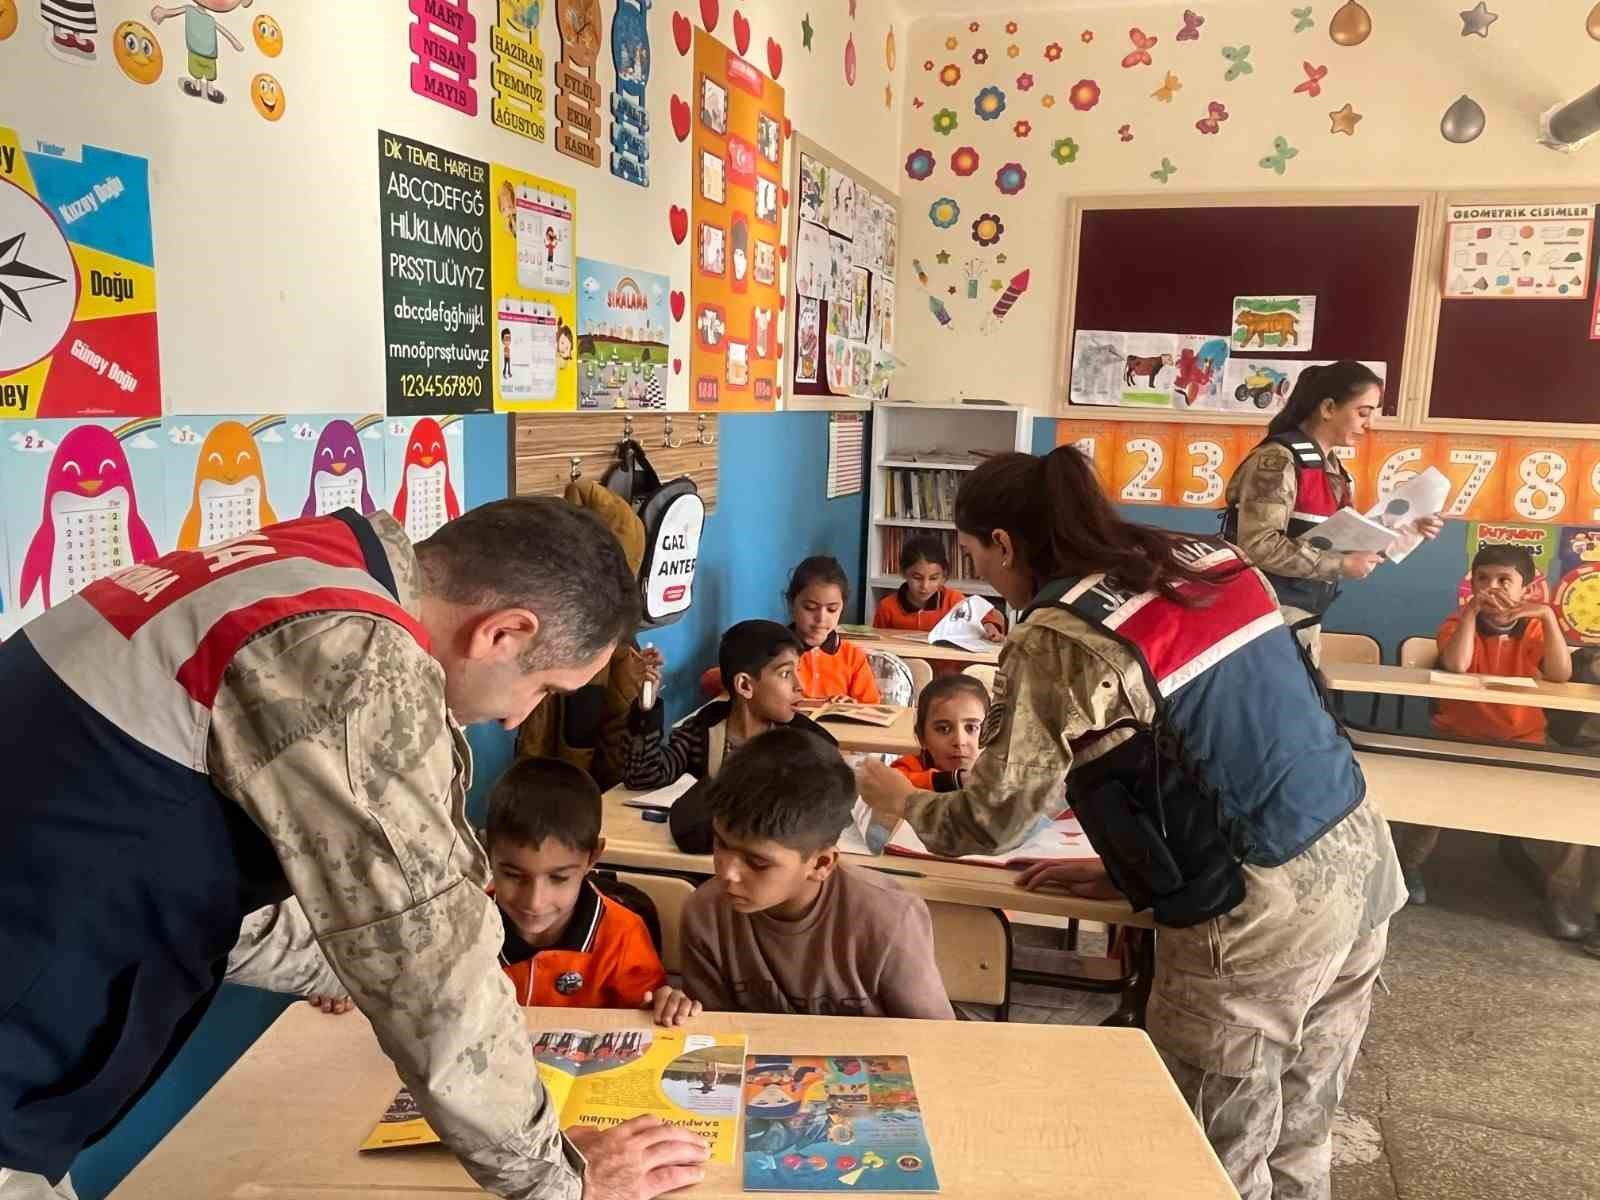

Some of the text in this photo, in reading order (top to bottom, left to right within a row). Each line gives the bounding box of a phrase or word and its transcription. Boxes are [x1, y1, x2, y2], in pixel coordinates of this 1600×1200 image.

[425, 0, 464, 31] MART
[424, 38, 466, 70] NİSAN
[495, 35, 543, 72] HAZİRAN
[424, 75, 466, 106] MAYIS
[496, 69, 543, 103] TEMMUZ
[496, 107, 545, 140] AĞUSTOS
[406, 145, 442, 173] TEMEL
[444, 160, 484, 183] HARFLER
[565, 136, 594, 160] KASIM
[387, 171, 485, 217] ABCÇDEFGĞ
[1453, 207, 1588, 219] GEOMETRİK CİSİMLER
[90, 270, 134, 302] Doğu
[70, 339, 138, 393] Güney Doğu
[399, 374, 482, 397] 1234567890
[25, 436, 33, 448] 2
[1120, 438, 1164, 501] 2
[1182, 441, 1224, 504] 3
[1446, 450, 1498, 515] 7
[1514, 451, 1568, 520] 8
[662, 534, 685, 551] GAZ
